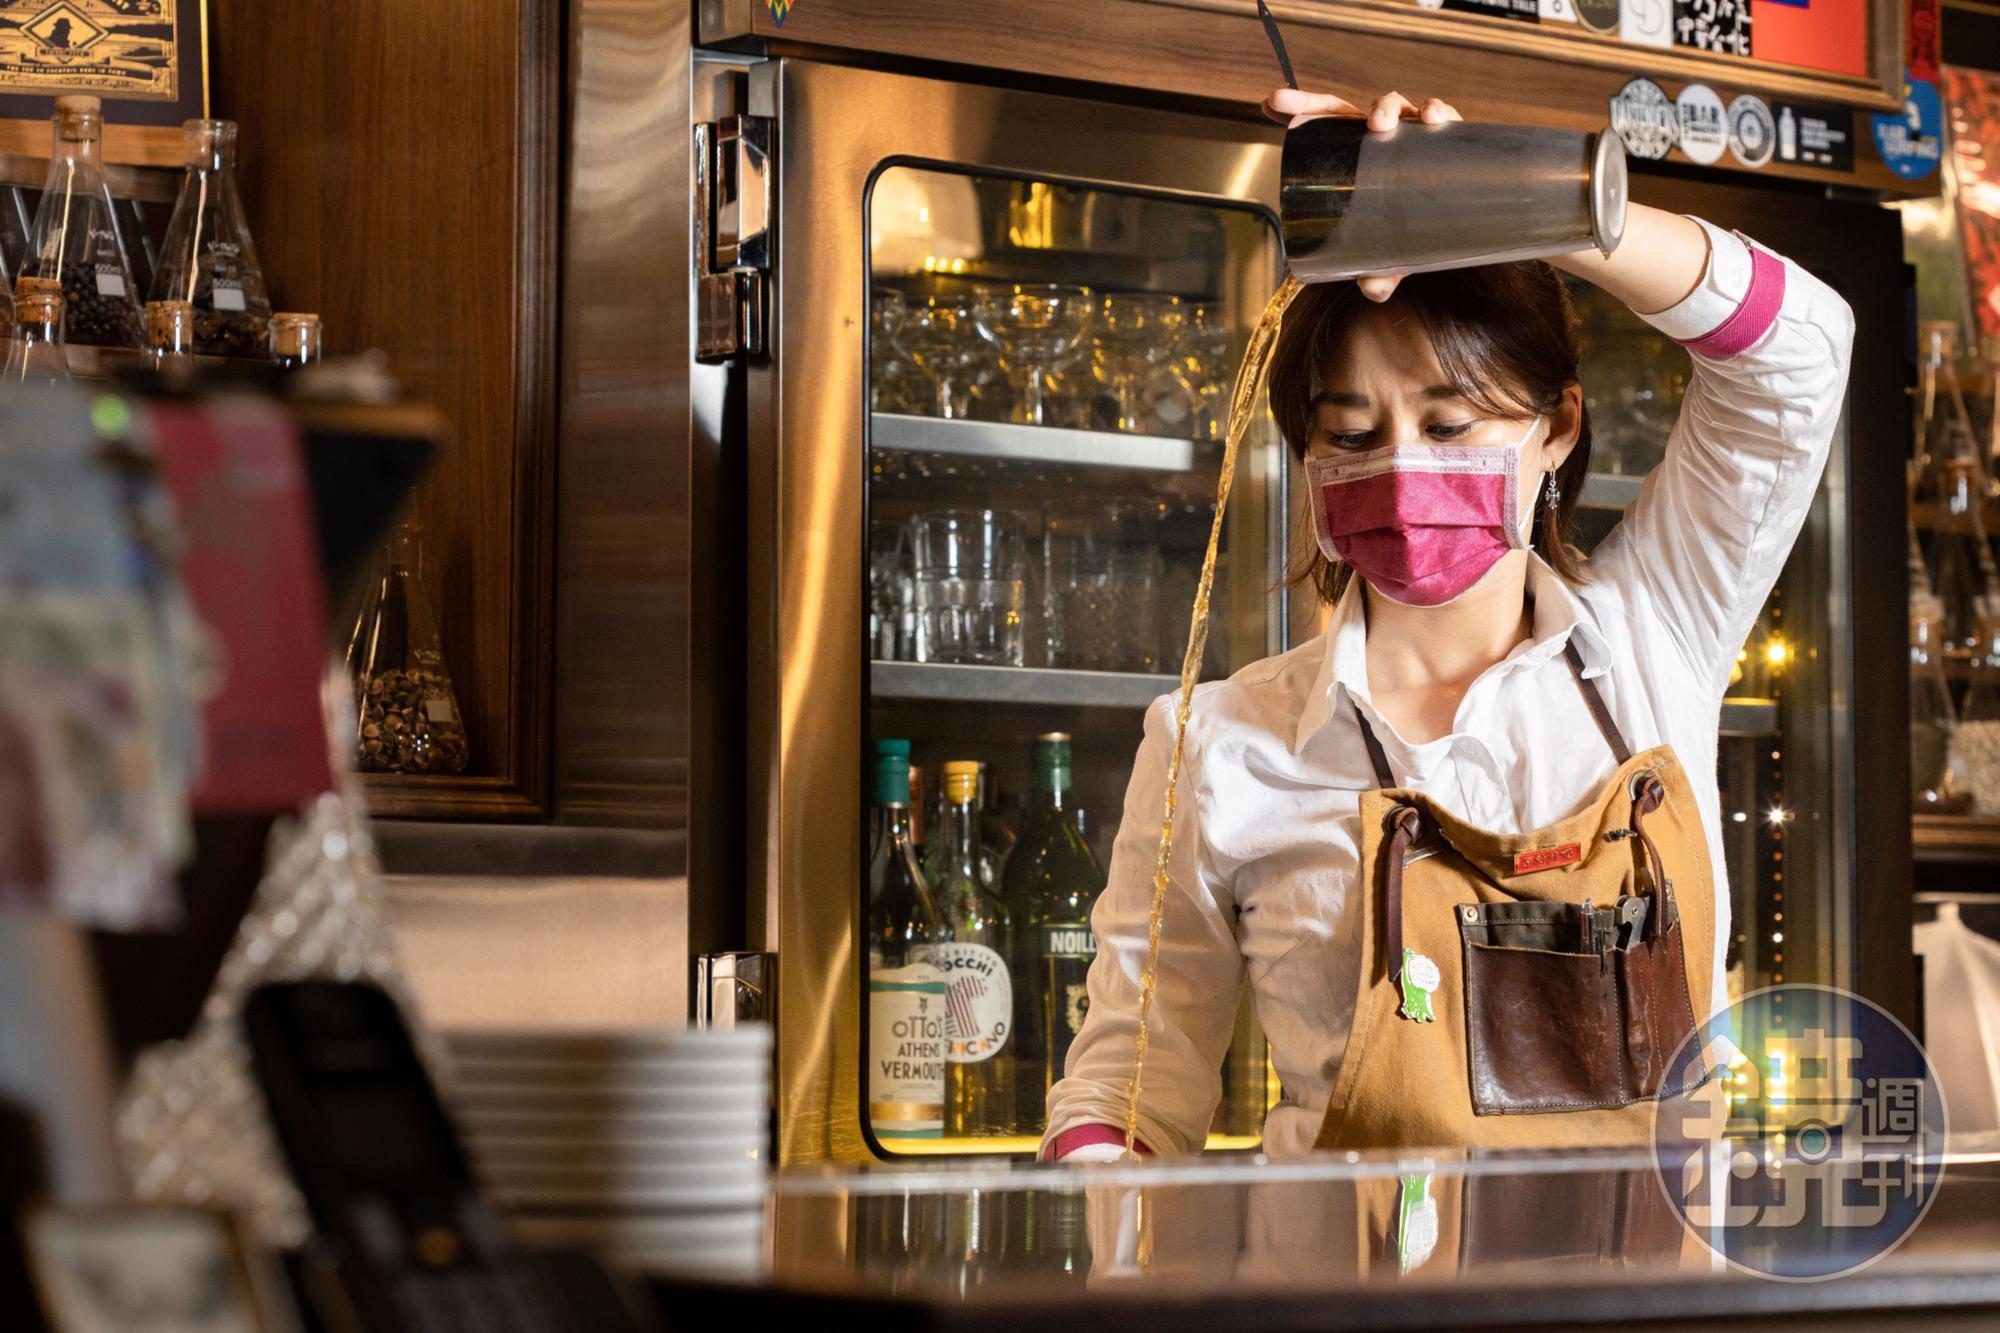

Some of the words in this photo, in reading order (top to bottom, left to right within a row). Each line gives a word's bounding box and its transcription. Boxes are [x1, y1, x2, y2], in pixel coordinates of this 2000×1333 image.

[1050, 931, 1097, 953] NOILL
[945, 957, 993, 977] OCCHI
[891, 1015, 943, 1039] OTTO'S
[897, 1041, 940, 1058] ATHENS
[947, 1021, 1006, 1056] RICANO
